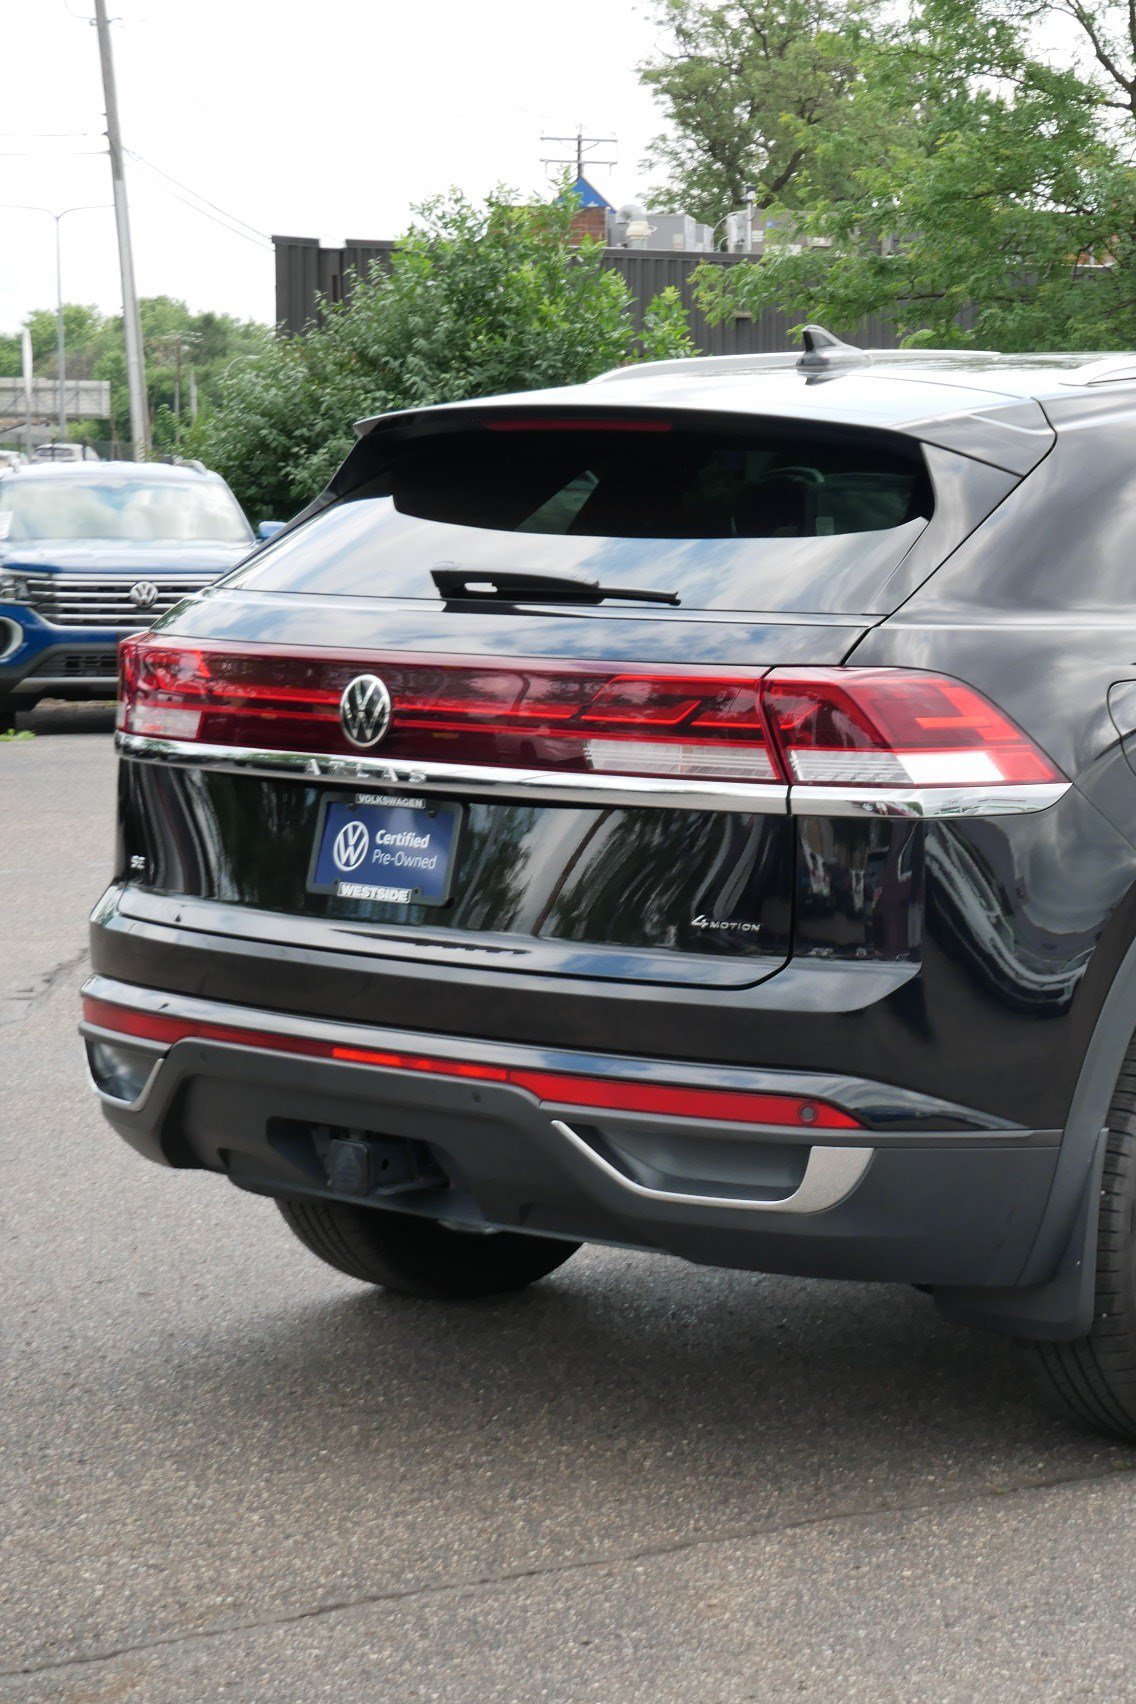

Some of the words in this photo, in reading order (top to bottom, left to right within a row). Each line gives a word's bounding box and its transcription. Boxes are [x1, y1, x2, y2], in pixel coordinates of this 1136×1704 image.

[305, 759, 427, 783] ATLAS
[358, 793, 425, 808] VOLKSWAGEN
[375, 829, 431, 849] Certified
[372, 849, 438, 870] Pre-Owned
[340, 883, 410, 903] WESTSIDE
[690, 914, 761, 932] 4MOTION
